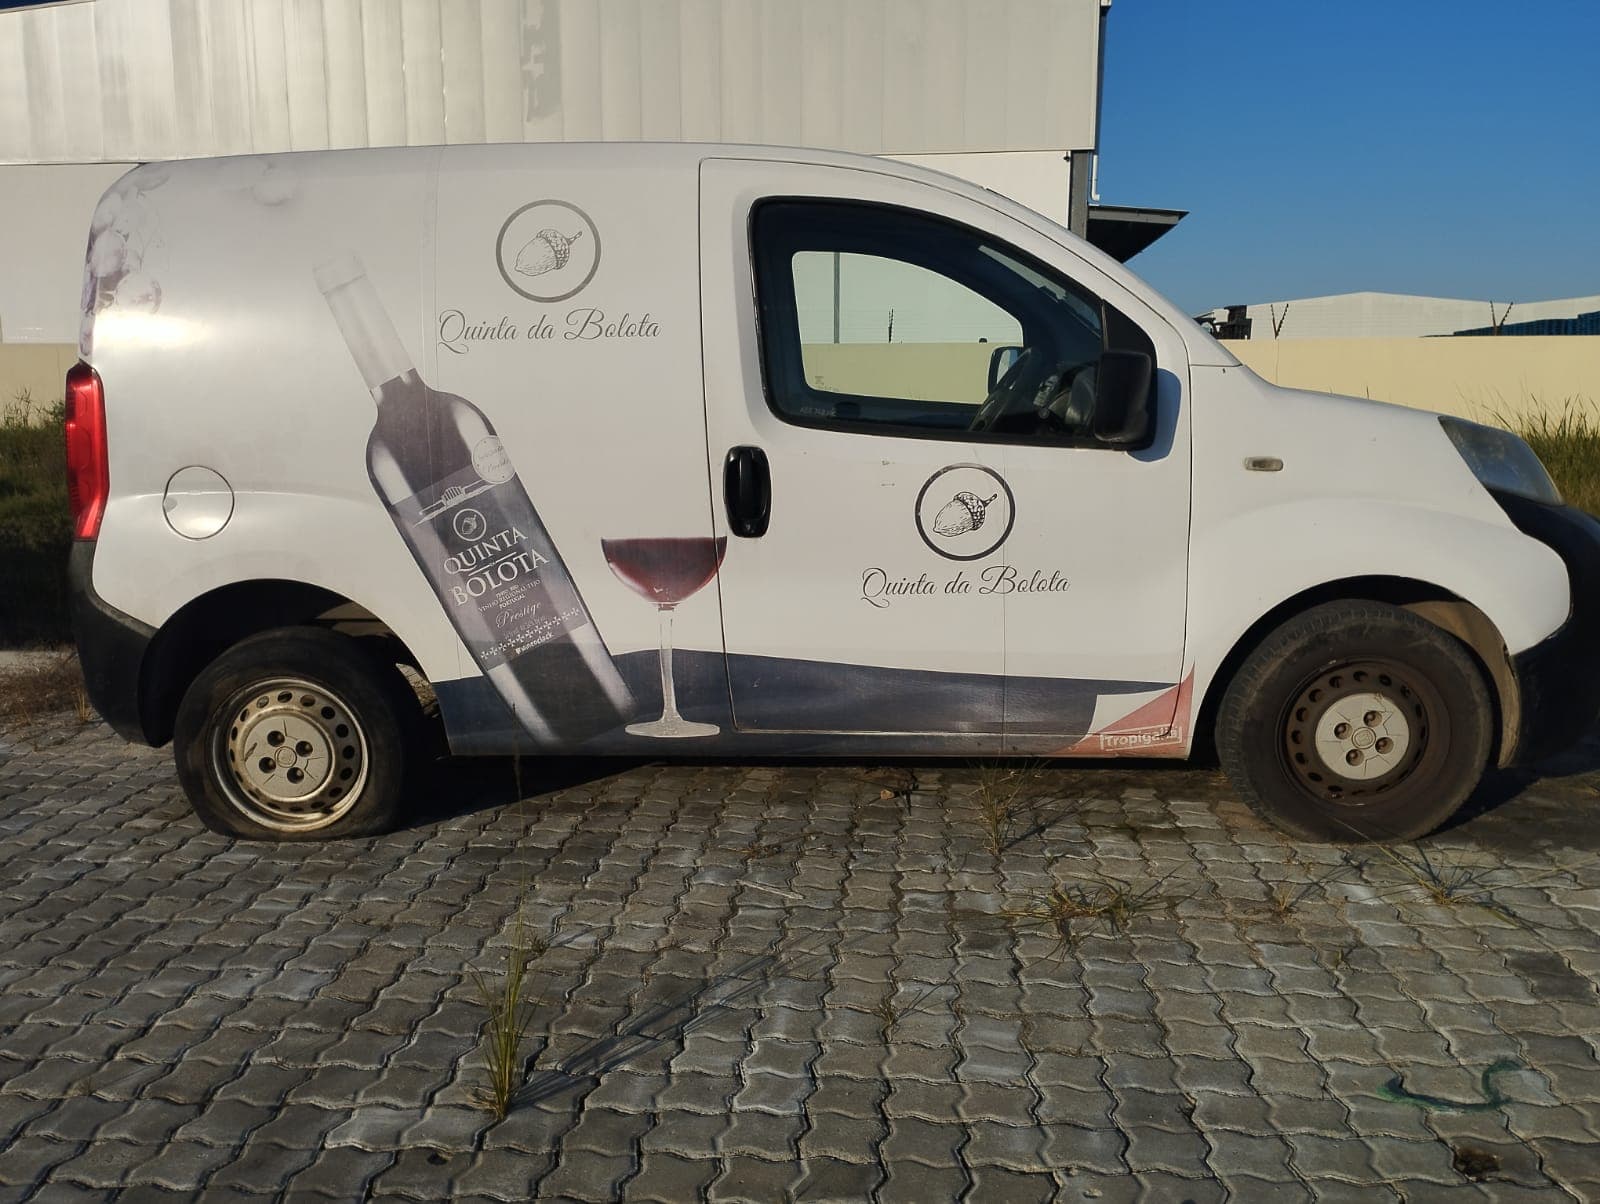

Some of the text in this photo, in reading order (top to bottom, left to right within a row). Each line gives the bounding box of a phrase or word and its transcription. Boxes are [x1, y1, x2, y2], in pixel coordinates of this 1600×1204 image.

[438, 307, 660, 354] Quinta da Bolota
[443, 527, 528, 575] QUINTA
[451, 549, 549, 605] BOLOTA
[861, 565, 1069, 608] Quinta da Bolota
[495, 600, 542, 629] Prestige
[499, 593, 525, 609] PORTUGAL
